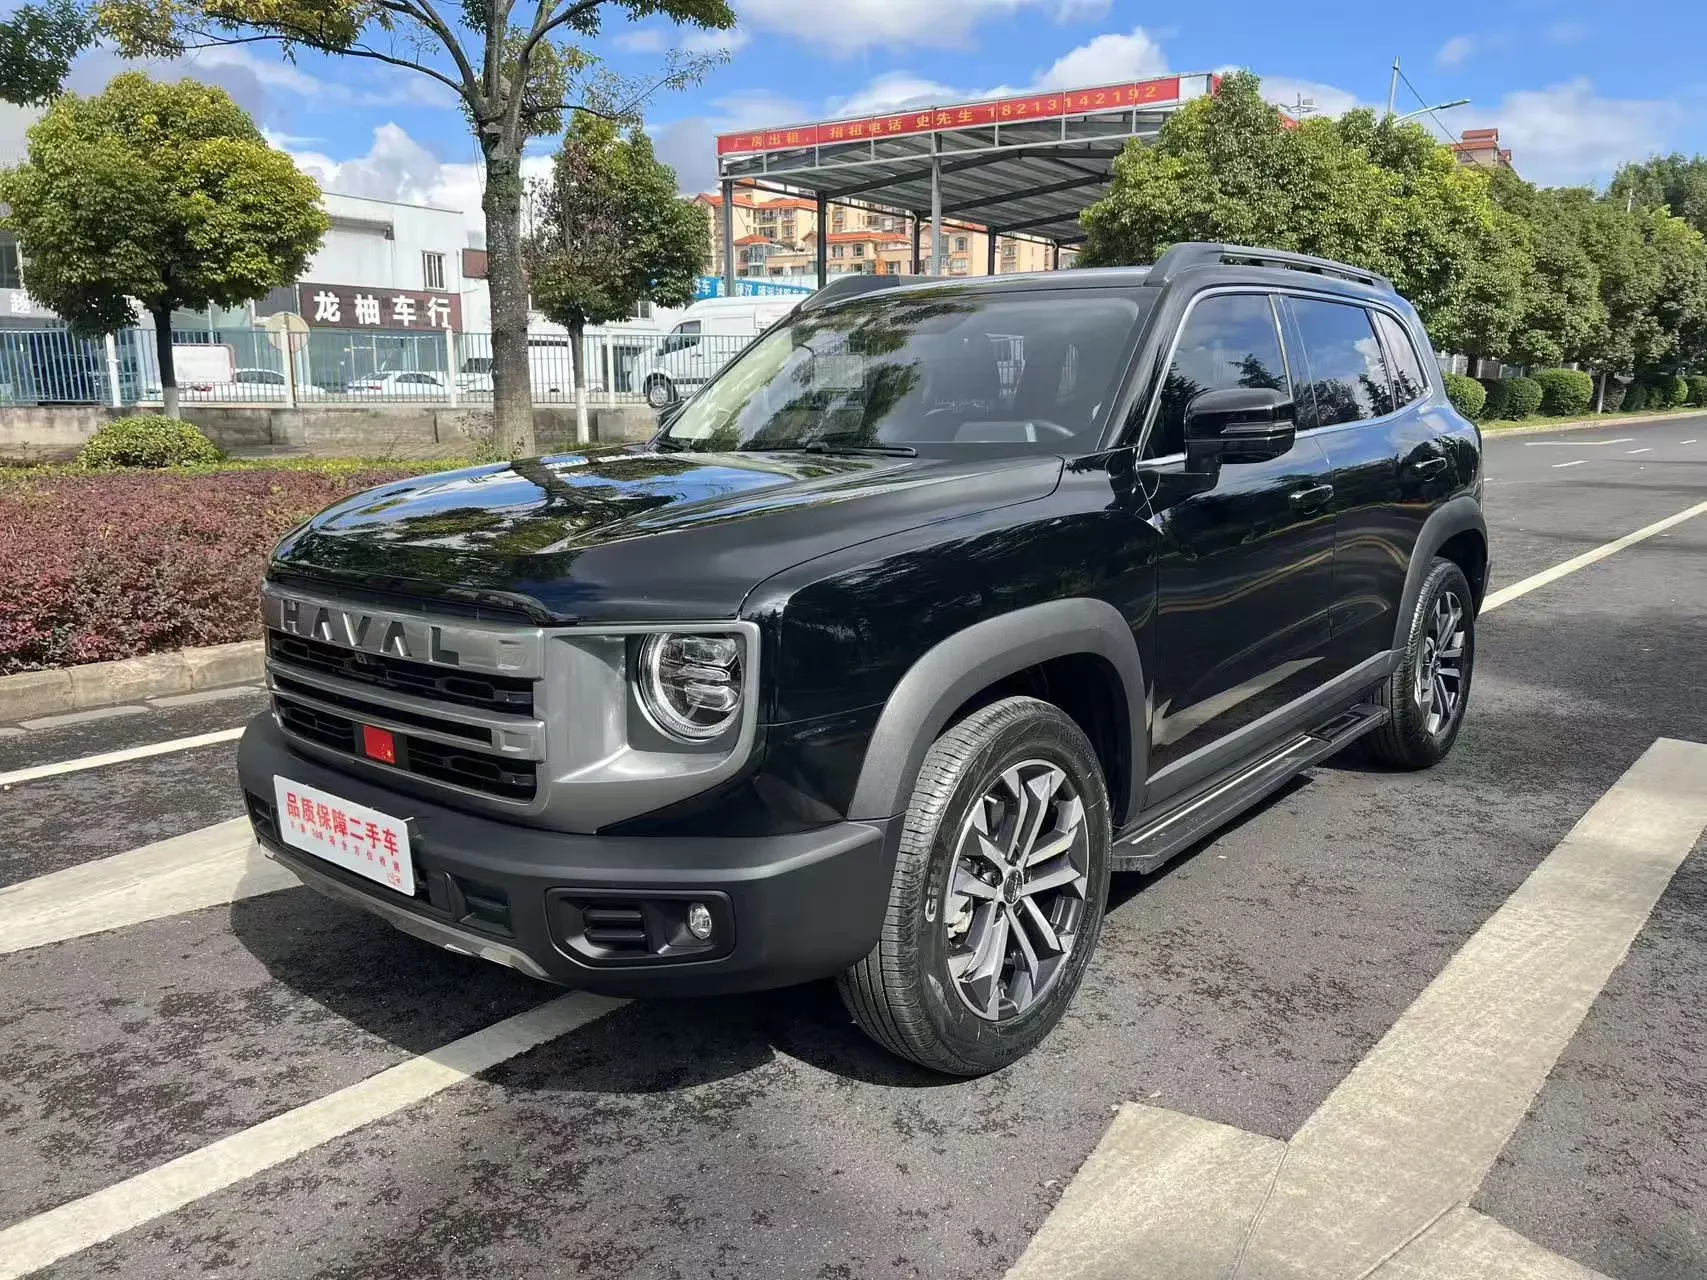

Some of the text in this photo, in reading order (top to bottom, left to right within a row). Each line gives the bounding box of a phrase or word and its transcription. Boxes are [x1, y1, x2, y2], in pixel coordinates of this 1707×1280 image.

[830, 119, 902, 139] 招租电话
[915, 108, 973, 128] 史先生
[987, 86, 1157, 117] 18213142192
[313, 290, 452, 329] 龙柚车行
[280, 598, 460, 667] HAVAL
[286, 791, 399, 857] 品质保障二手车
